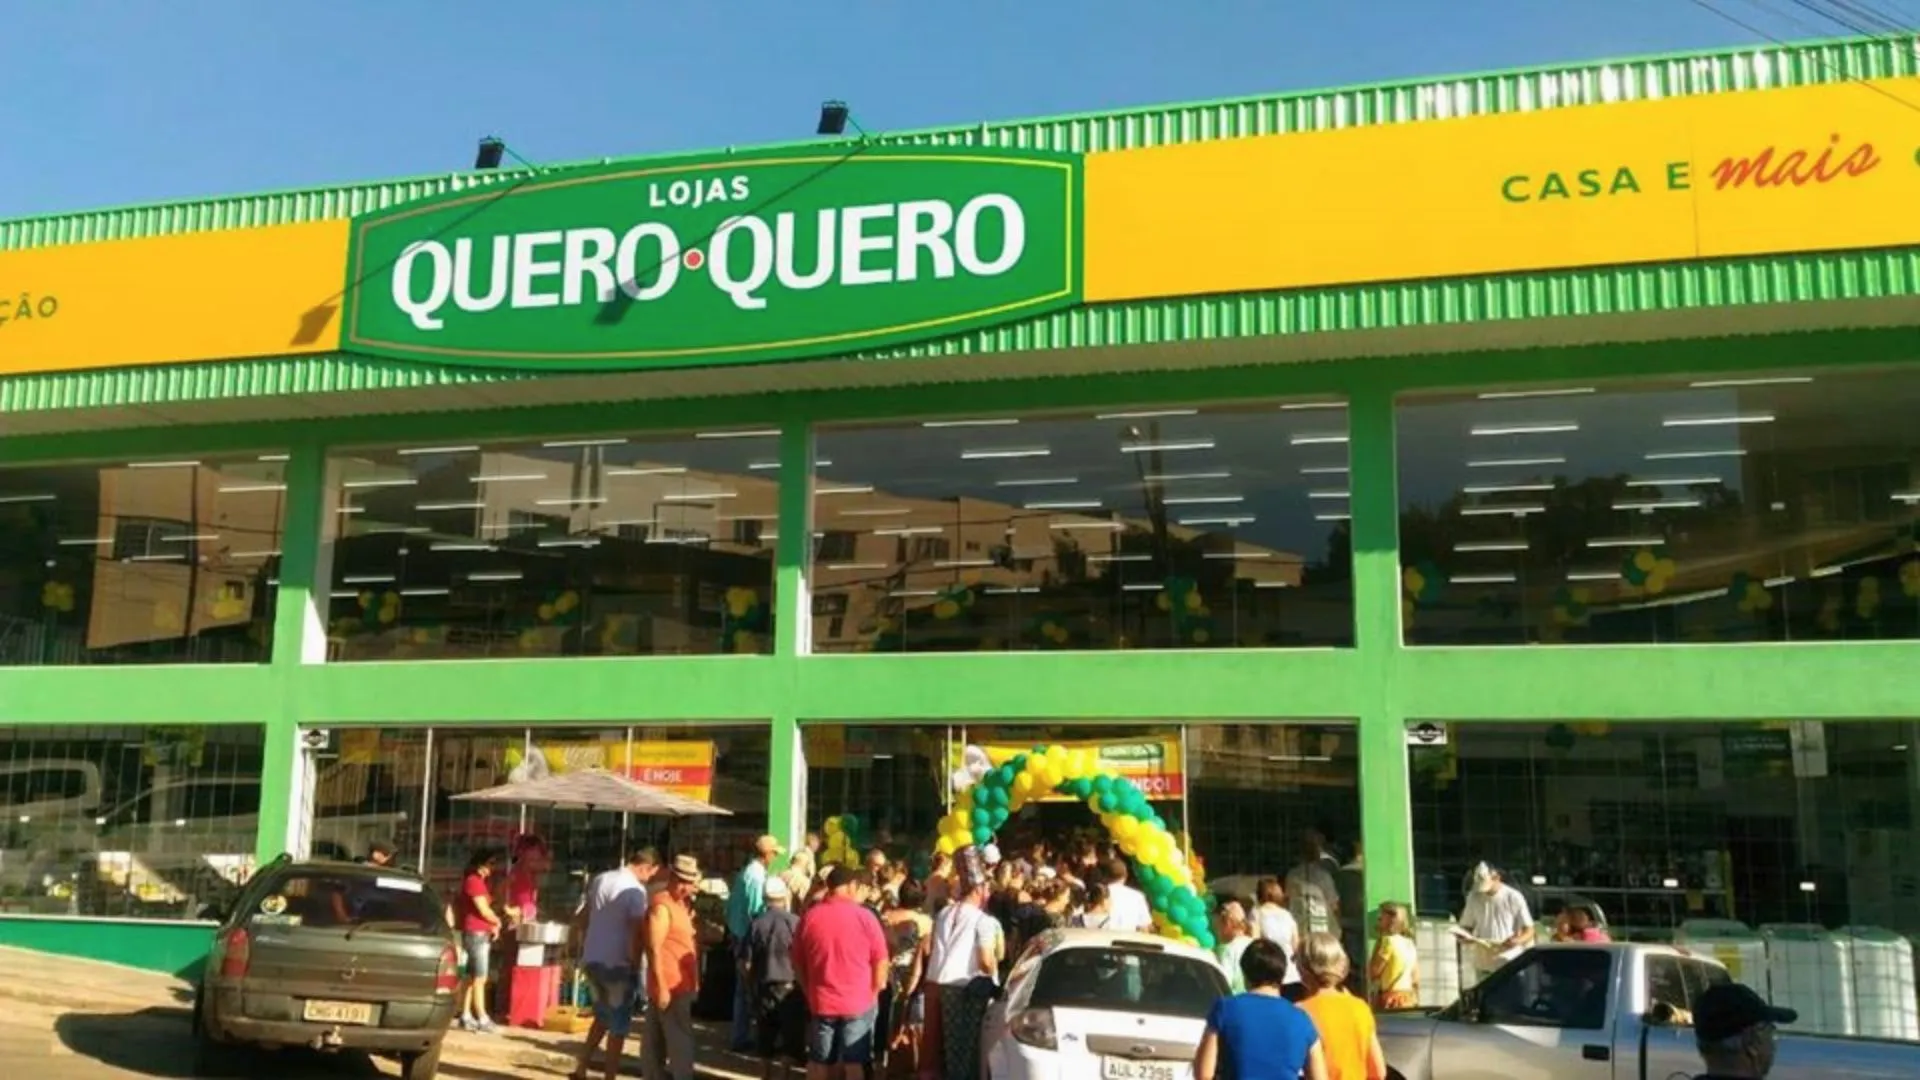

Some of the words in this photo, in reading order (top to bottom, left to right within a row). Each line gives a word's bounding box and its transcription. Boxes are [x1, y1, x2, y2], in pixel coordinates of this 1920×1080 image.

[649, 175, 750, 208] LOJAS
[1501, 166, 1640, 202] CASA
[1666, 161, 1691, 190] E
[1710, 133, 1881, 191] mais
[392, 222, 679, 329] QUERO
[707, 193, 1025, 309] QUERO
